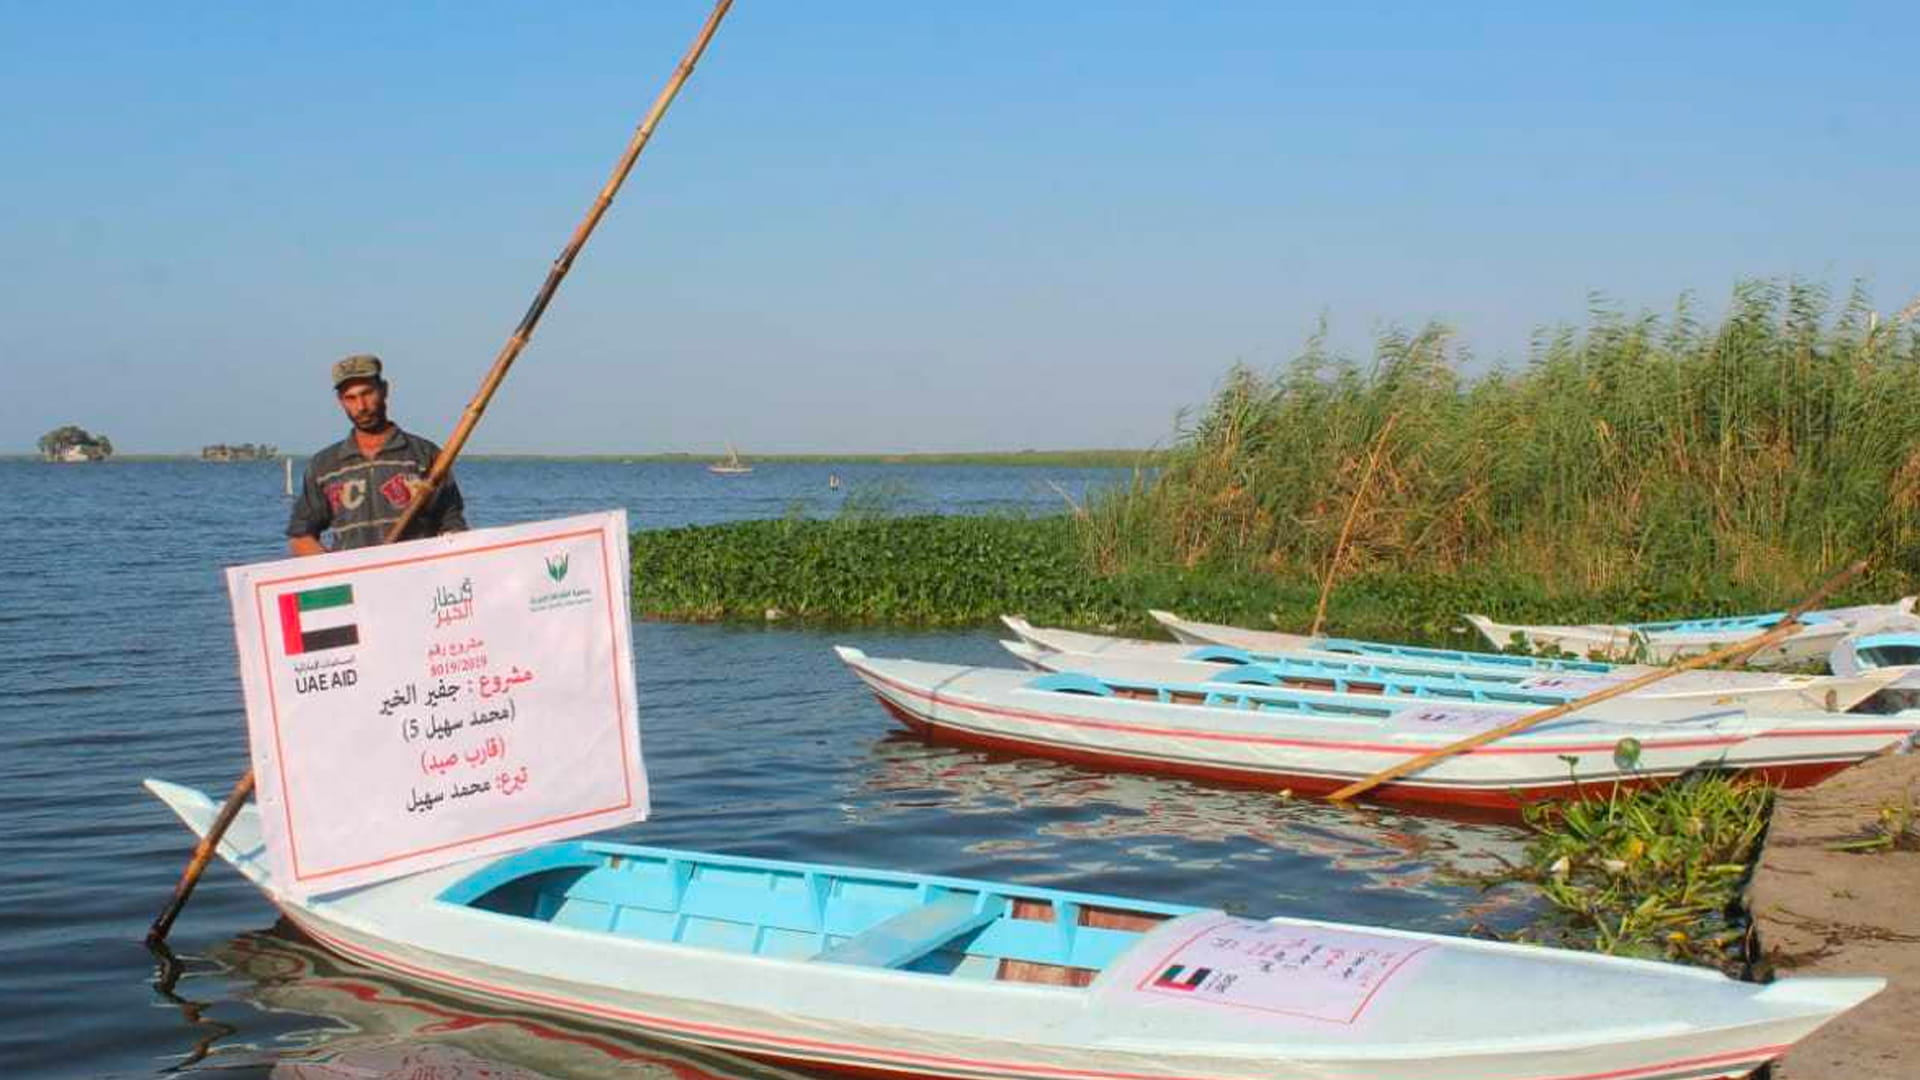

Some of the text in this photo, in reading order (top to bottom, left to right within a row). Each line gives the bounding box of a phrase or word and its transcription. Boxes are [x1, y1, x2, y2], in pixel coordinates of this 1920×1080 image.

[295, 669, 358, 694] UAE AID
[424, 678, 461, 707] جفير
[378, 682, 417, 715] الخير
[425, 714, 463, 740] سهيل
[406, 786, 445, 812] سهيل
[451, 780, 492, 799] محمد
